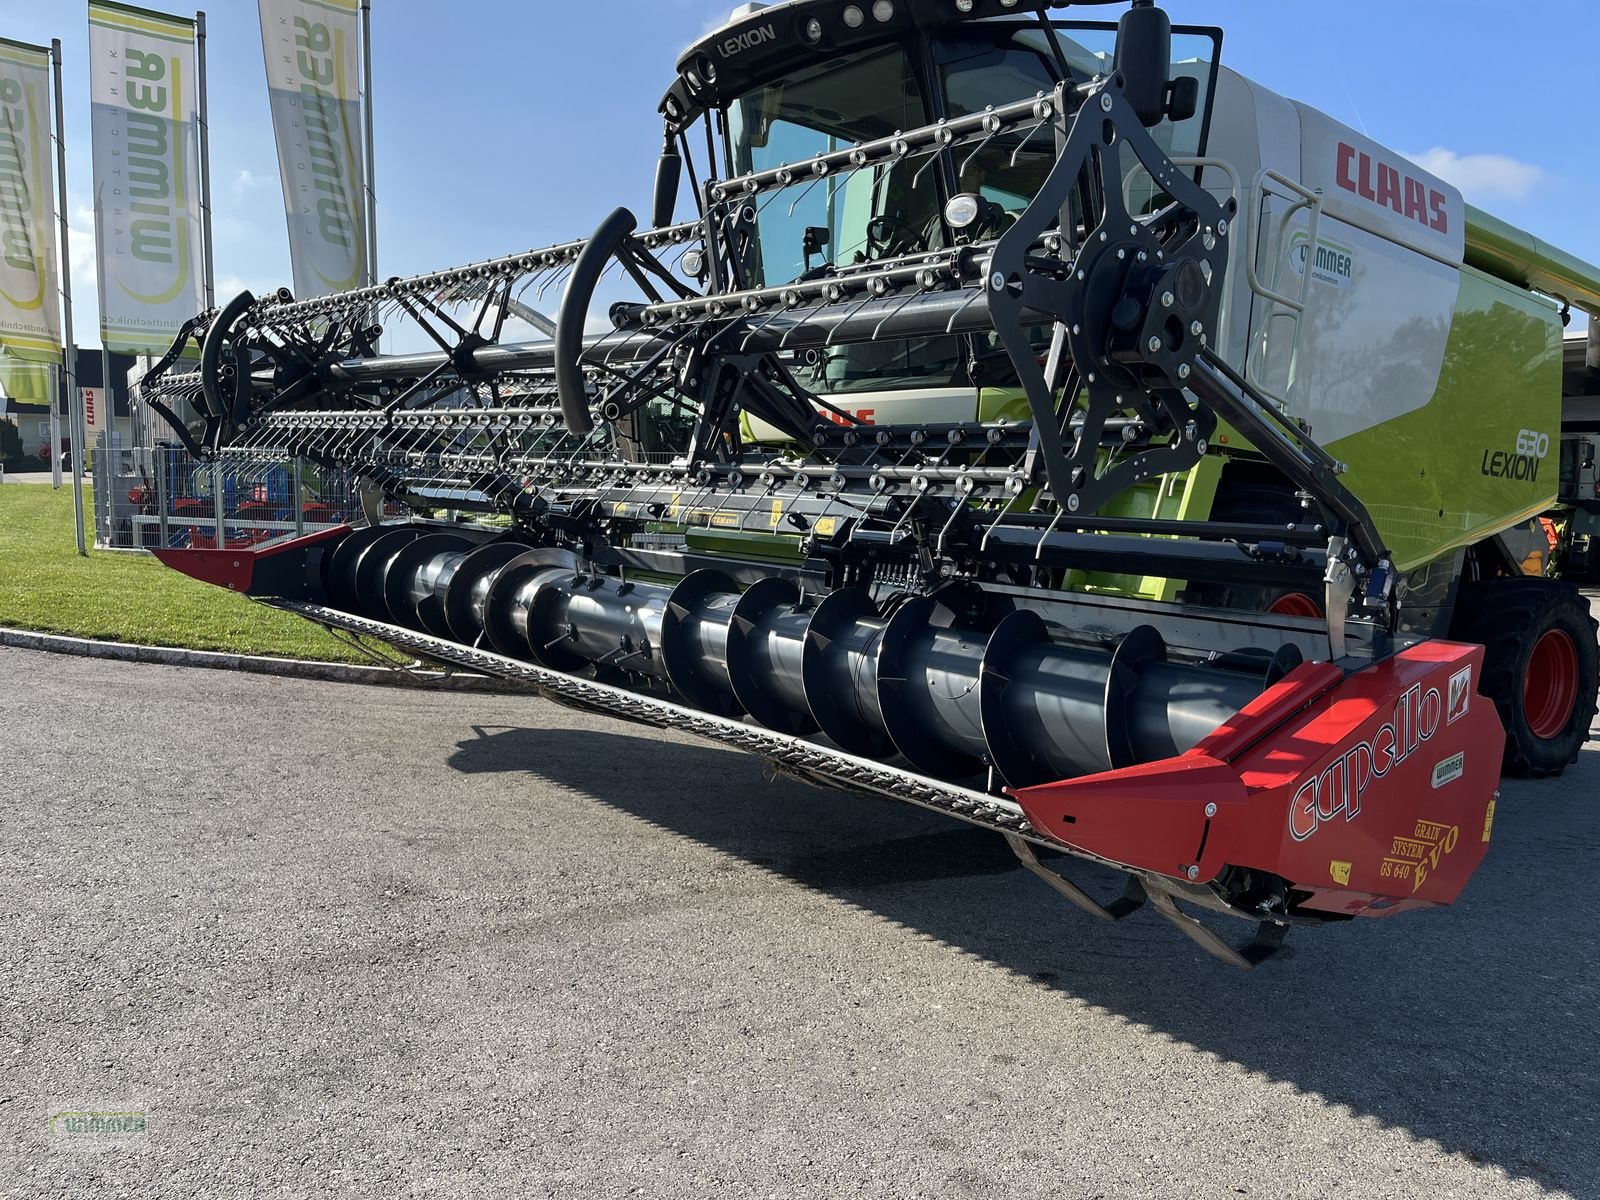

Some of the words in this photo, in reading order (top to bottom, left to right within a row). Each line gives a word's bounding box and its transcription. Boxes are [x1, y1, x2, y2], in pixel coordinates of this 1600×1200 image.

[717, 23, 776, 58] LEXION
[1336, 142, 1447, 234] CLAAS
[86, 389, 95, 426] CLAAS
[1516, 428, 1549, 458] 630
[1481, 449, 1539, 482] LEXION
[1289, 682, 1441, 841] Capello
[1391, 840, 1424, 858] SYSTEM
[1414, 823, 1441, 841] GRAIN
[1380, 862, 1393, 877] GS
[1393, 864, 1410, 879] 640
[1412, 826, 1458, 894] EVO
